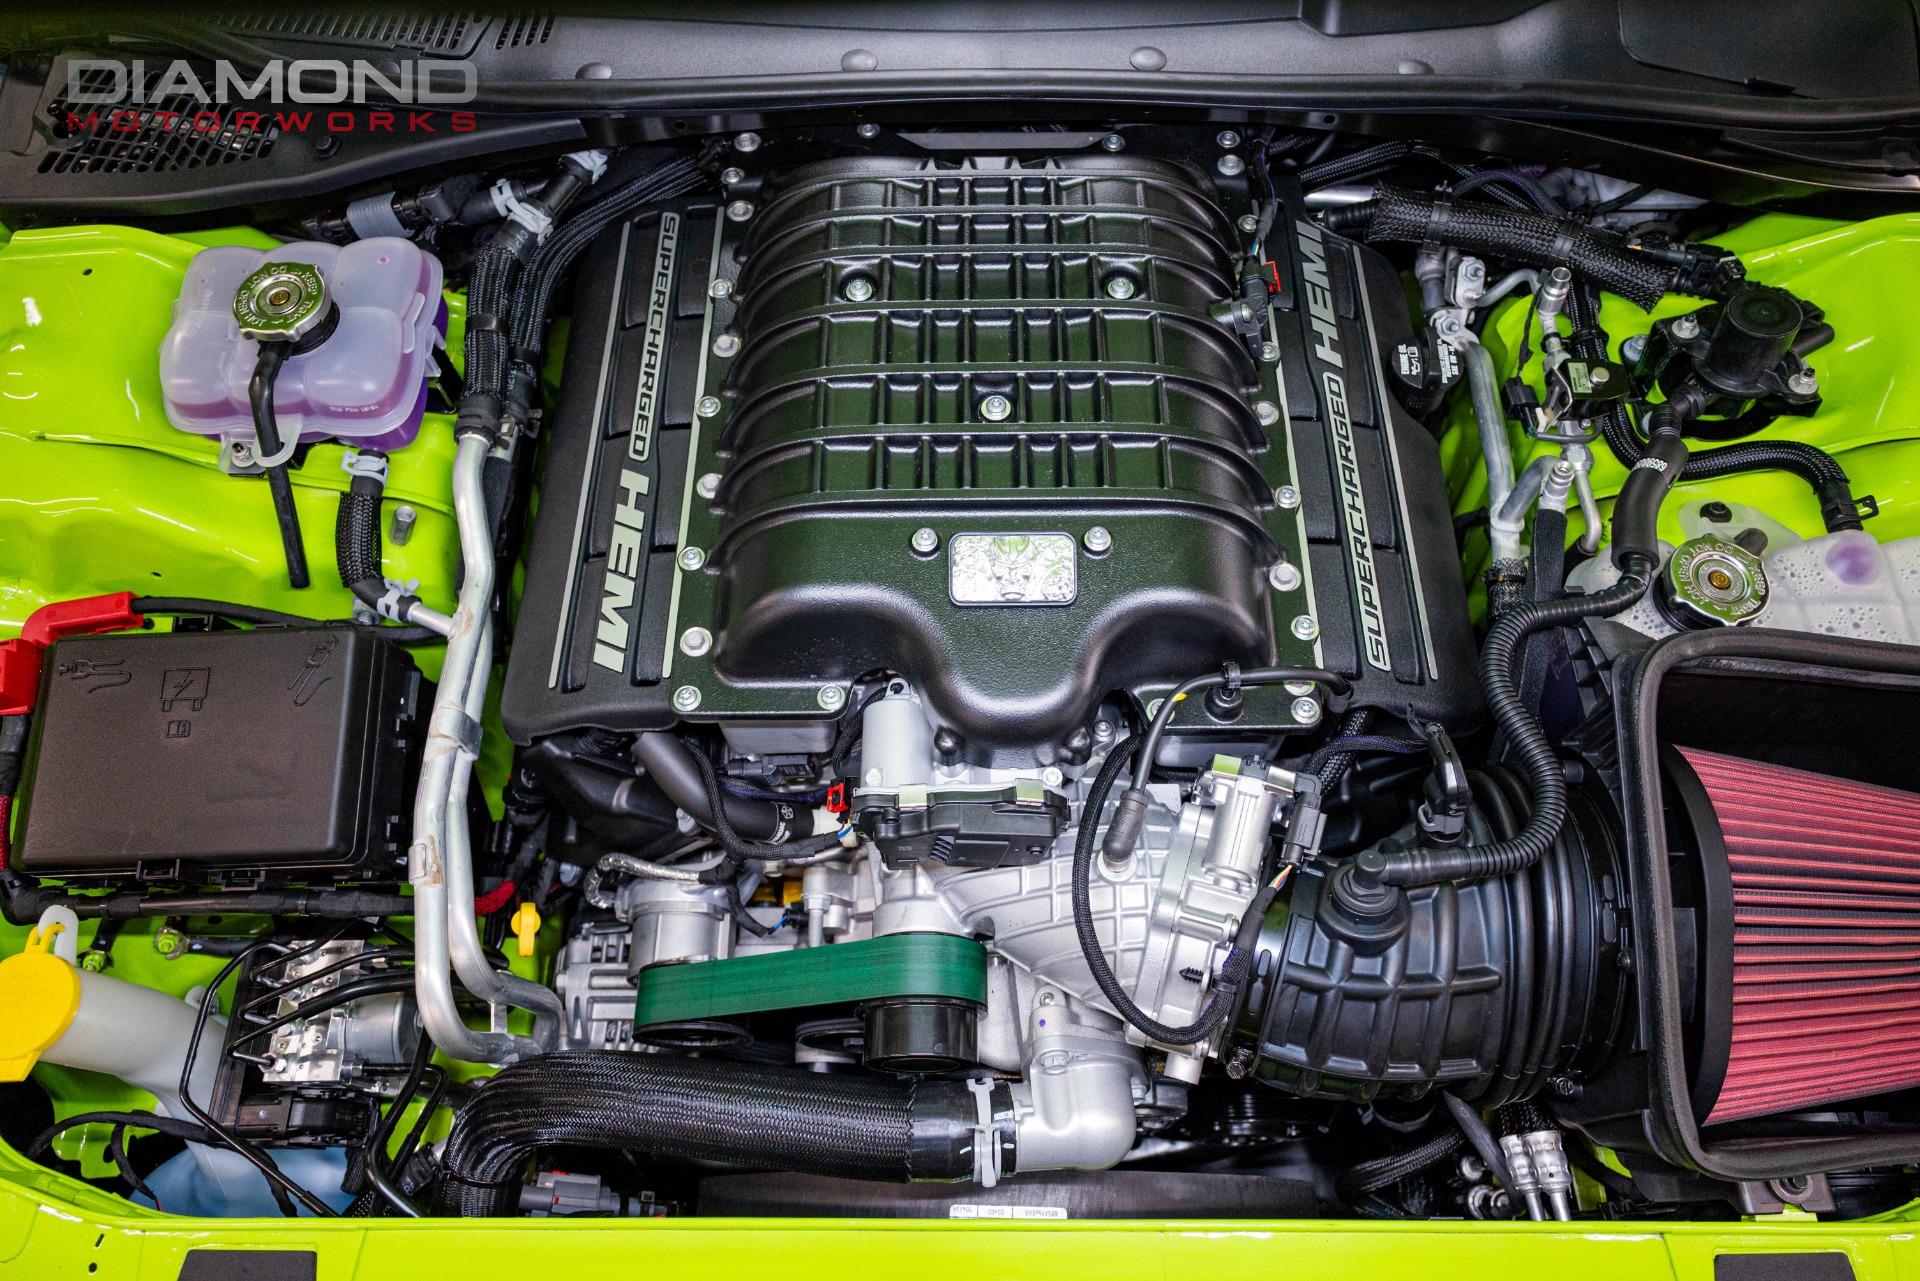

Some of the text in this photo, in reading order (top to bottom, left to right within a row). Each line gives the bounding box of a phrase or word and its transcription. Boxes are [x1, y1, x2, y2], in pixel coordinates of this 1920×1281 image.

[593, 215, 676, 673] SUPERCHARGED HEMI
[1295, 220, 1389, 667] SUPERCHARGED HEMI
